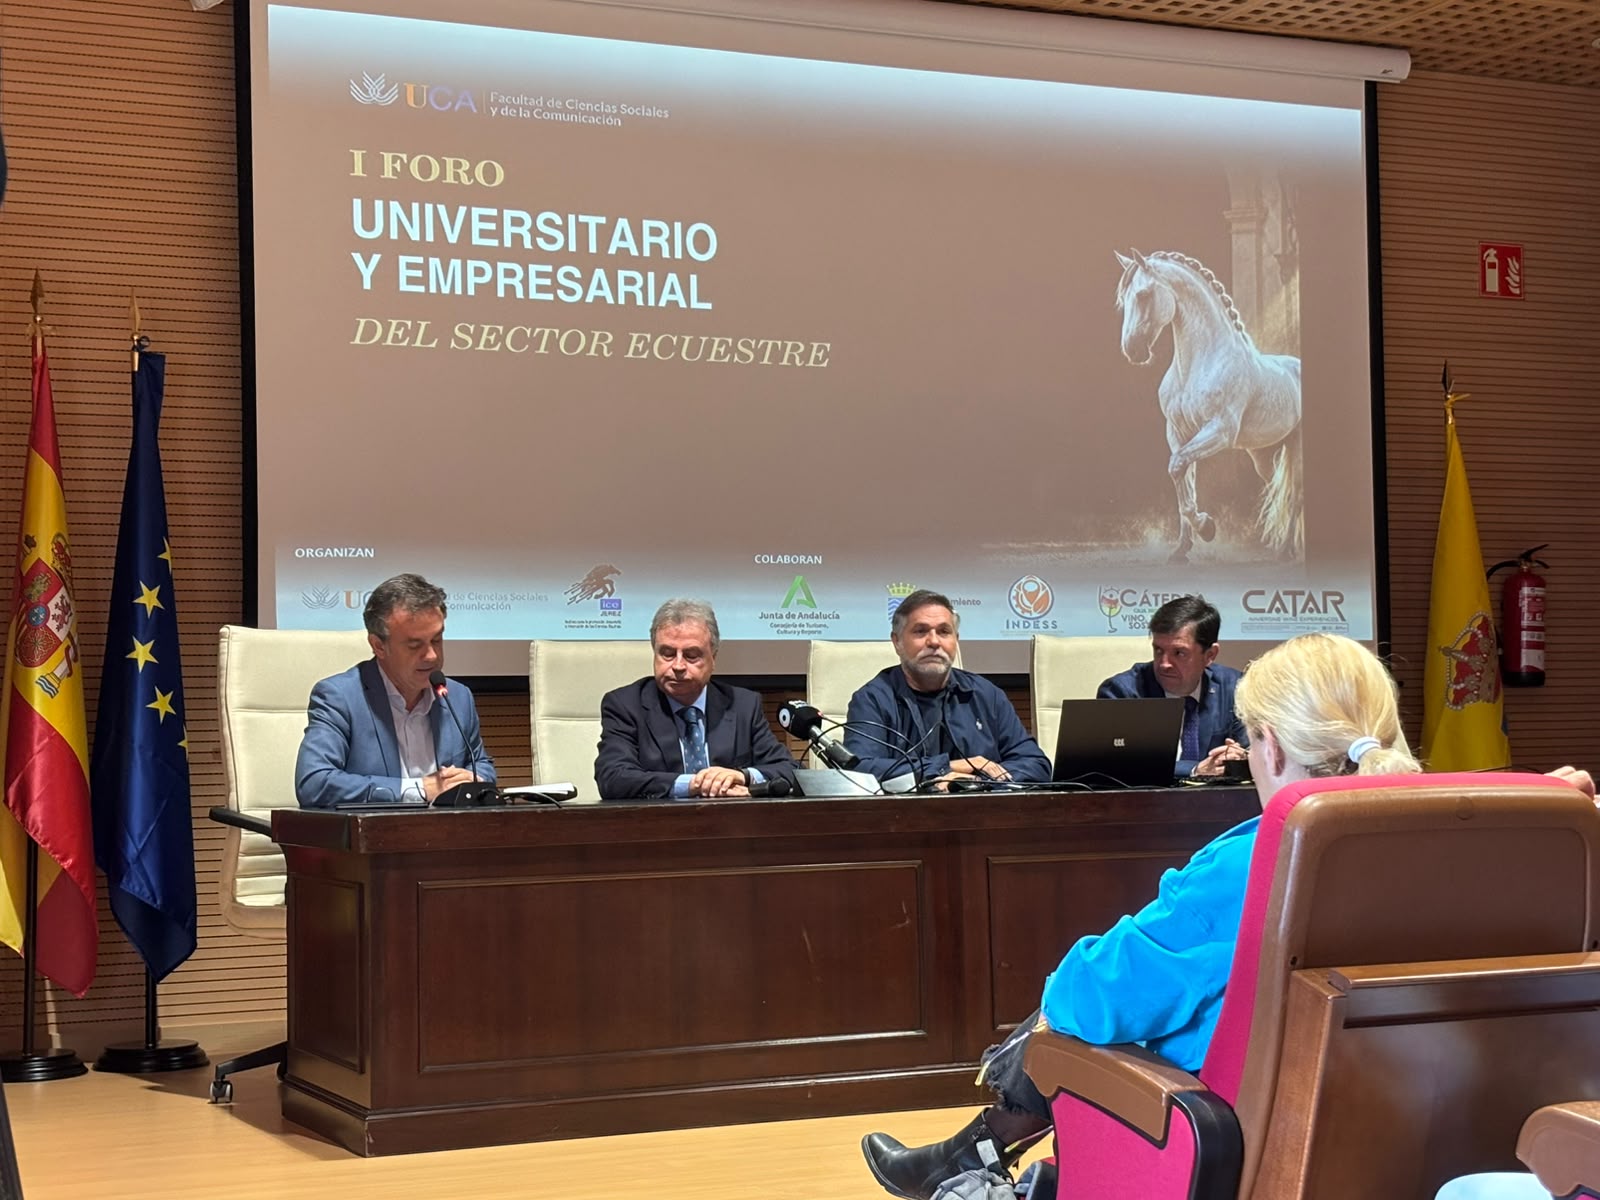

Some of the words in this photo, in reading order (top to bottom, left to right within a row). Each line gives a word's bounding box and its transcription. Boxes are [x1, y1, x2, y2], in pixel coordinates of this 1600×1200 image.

[403, 82, 477, 113] UCA
[490, 91, 543, 107] Facultad
[547, 97, 562, 109] de
[565, 99, 617, 114] Ciencias
[620, 104, 669, 119] Sociales
[490, 106, 497, 117] y
[501, 106, 517, 117] de
[519, 107, 530, 118] la
[533, 108, 622, 127] Comunicación
[349, 149, 367, 177] I
[380, 151, 505, 188] FORO
[351, 198, 718, 262] UNIVERSITARIO
[350, 252, 382, 290] Y
[398, 254, 713, 310] EMPRESARIAL
[350, 318, 439, 349] DEL
[450, 322, 614, 358] SECTOR
[624, 332, 831, 368] ECUESTRE
[294, 547, 375, 559] ORGANIZAN
[754, 553, 823, 565] COLABORAN
[467, 592, 508, 602] Ciencias
[510, 592, 549, 602] Sociales
[1242, 590, 1347, 622] CATAR
[758, 611, 783, 620] Junta
[785, 611, 796, 620] de
[797, 610, 840, 620] Andalucía
[1006, 619, 1058, 630] INDESS
